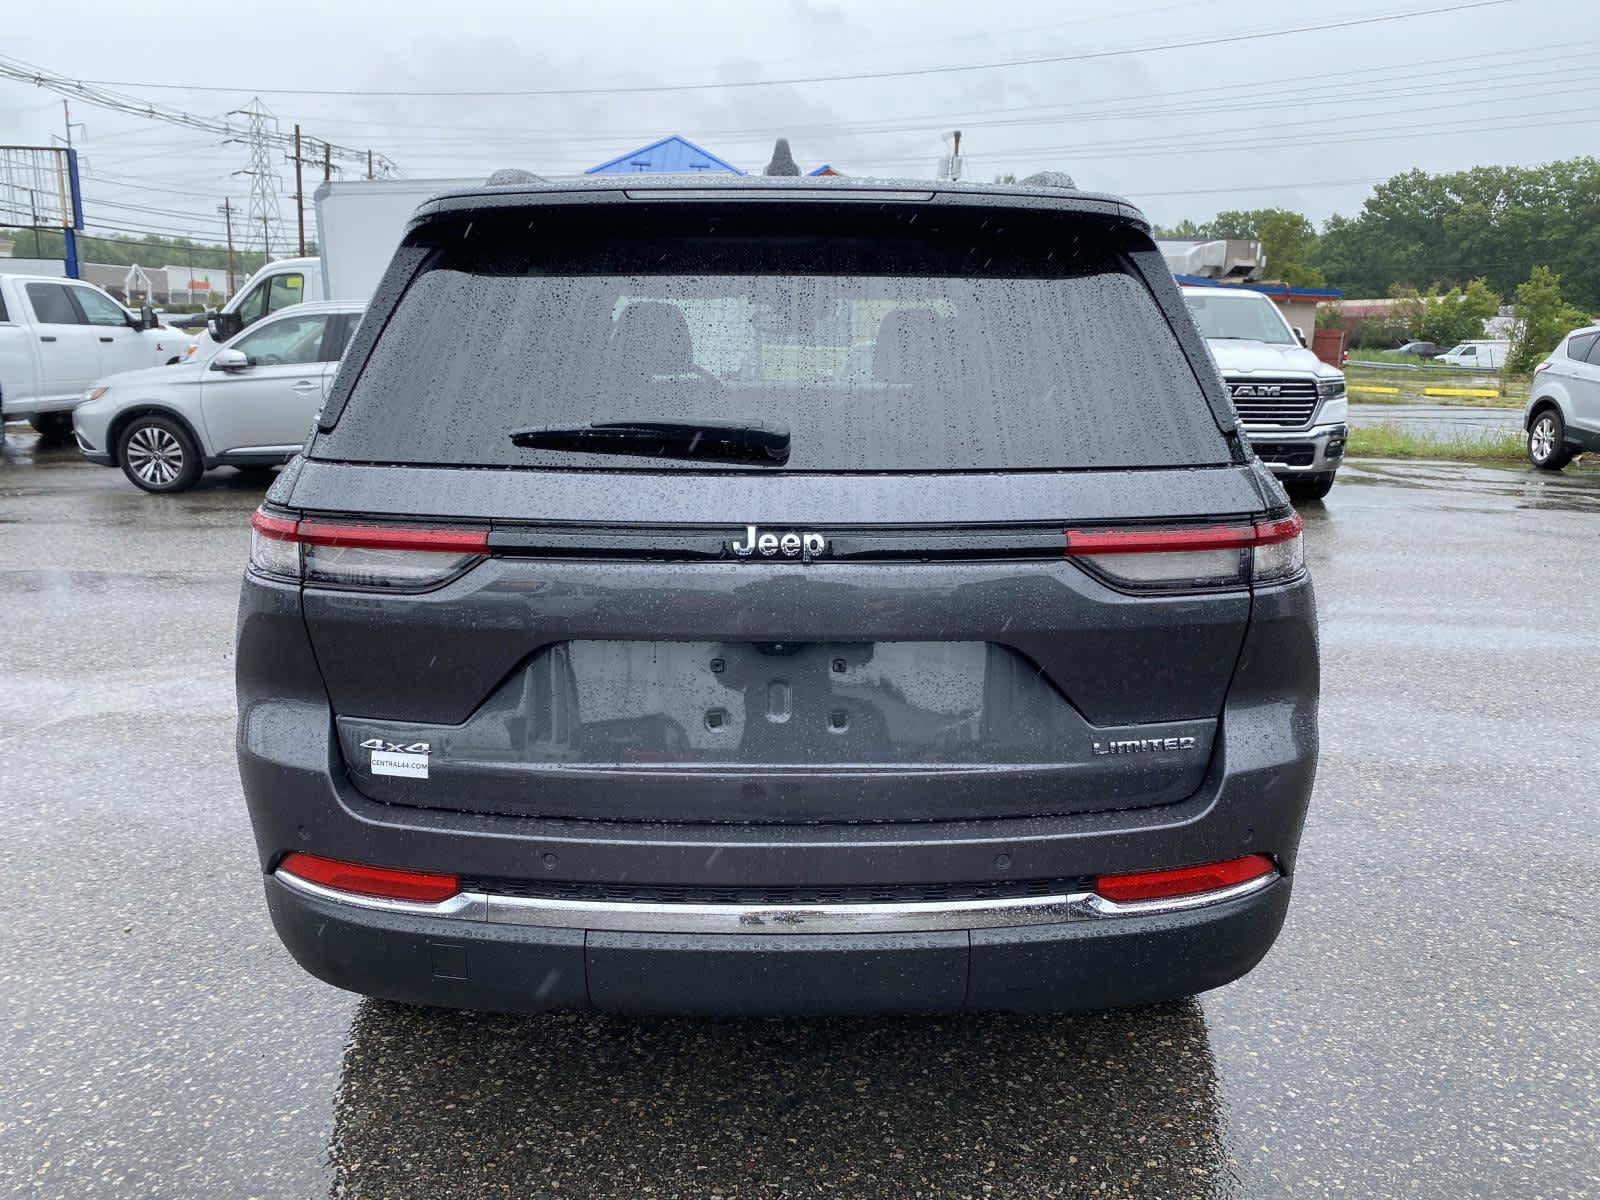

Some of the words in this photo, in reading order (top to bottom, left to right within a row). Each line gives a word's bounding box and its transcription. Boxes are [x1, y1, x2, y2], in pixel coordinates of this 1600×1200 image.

[732, 526, 825, 562] Jeep
[360, 738, 433, 755] 4x4
[1092, 736, 1196, 755] LIMITED
[371, 759, 428, 770] CENTRAL44.COM
